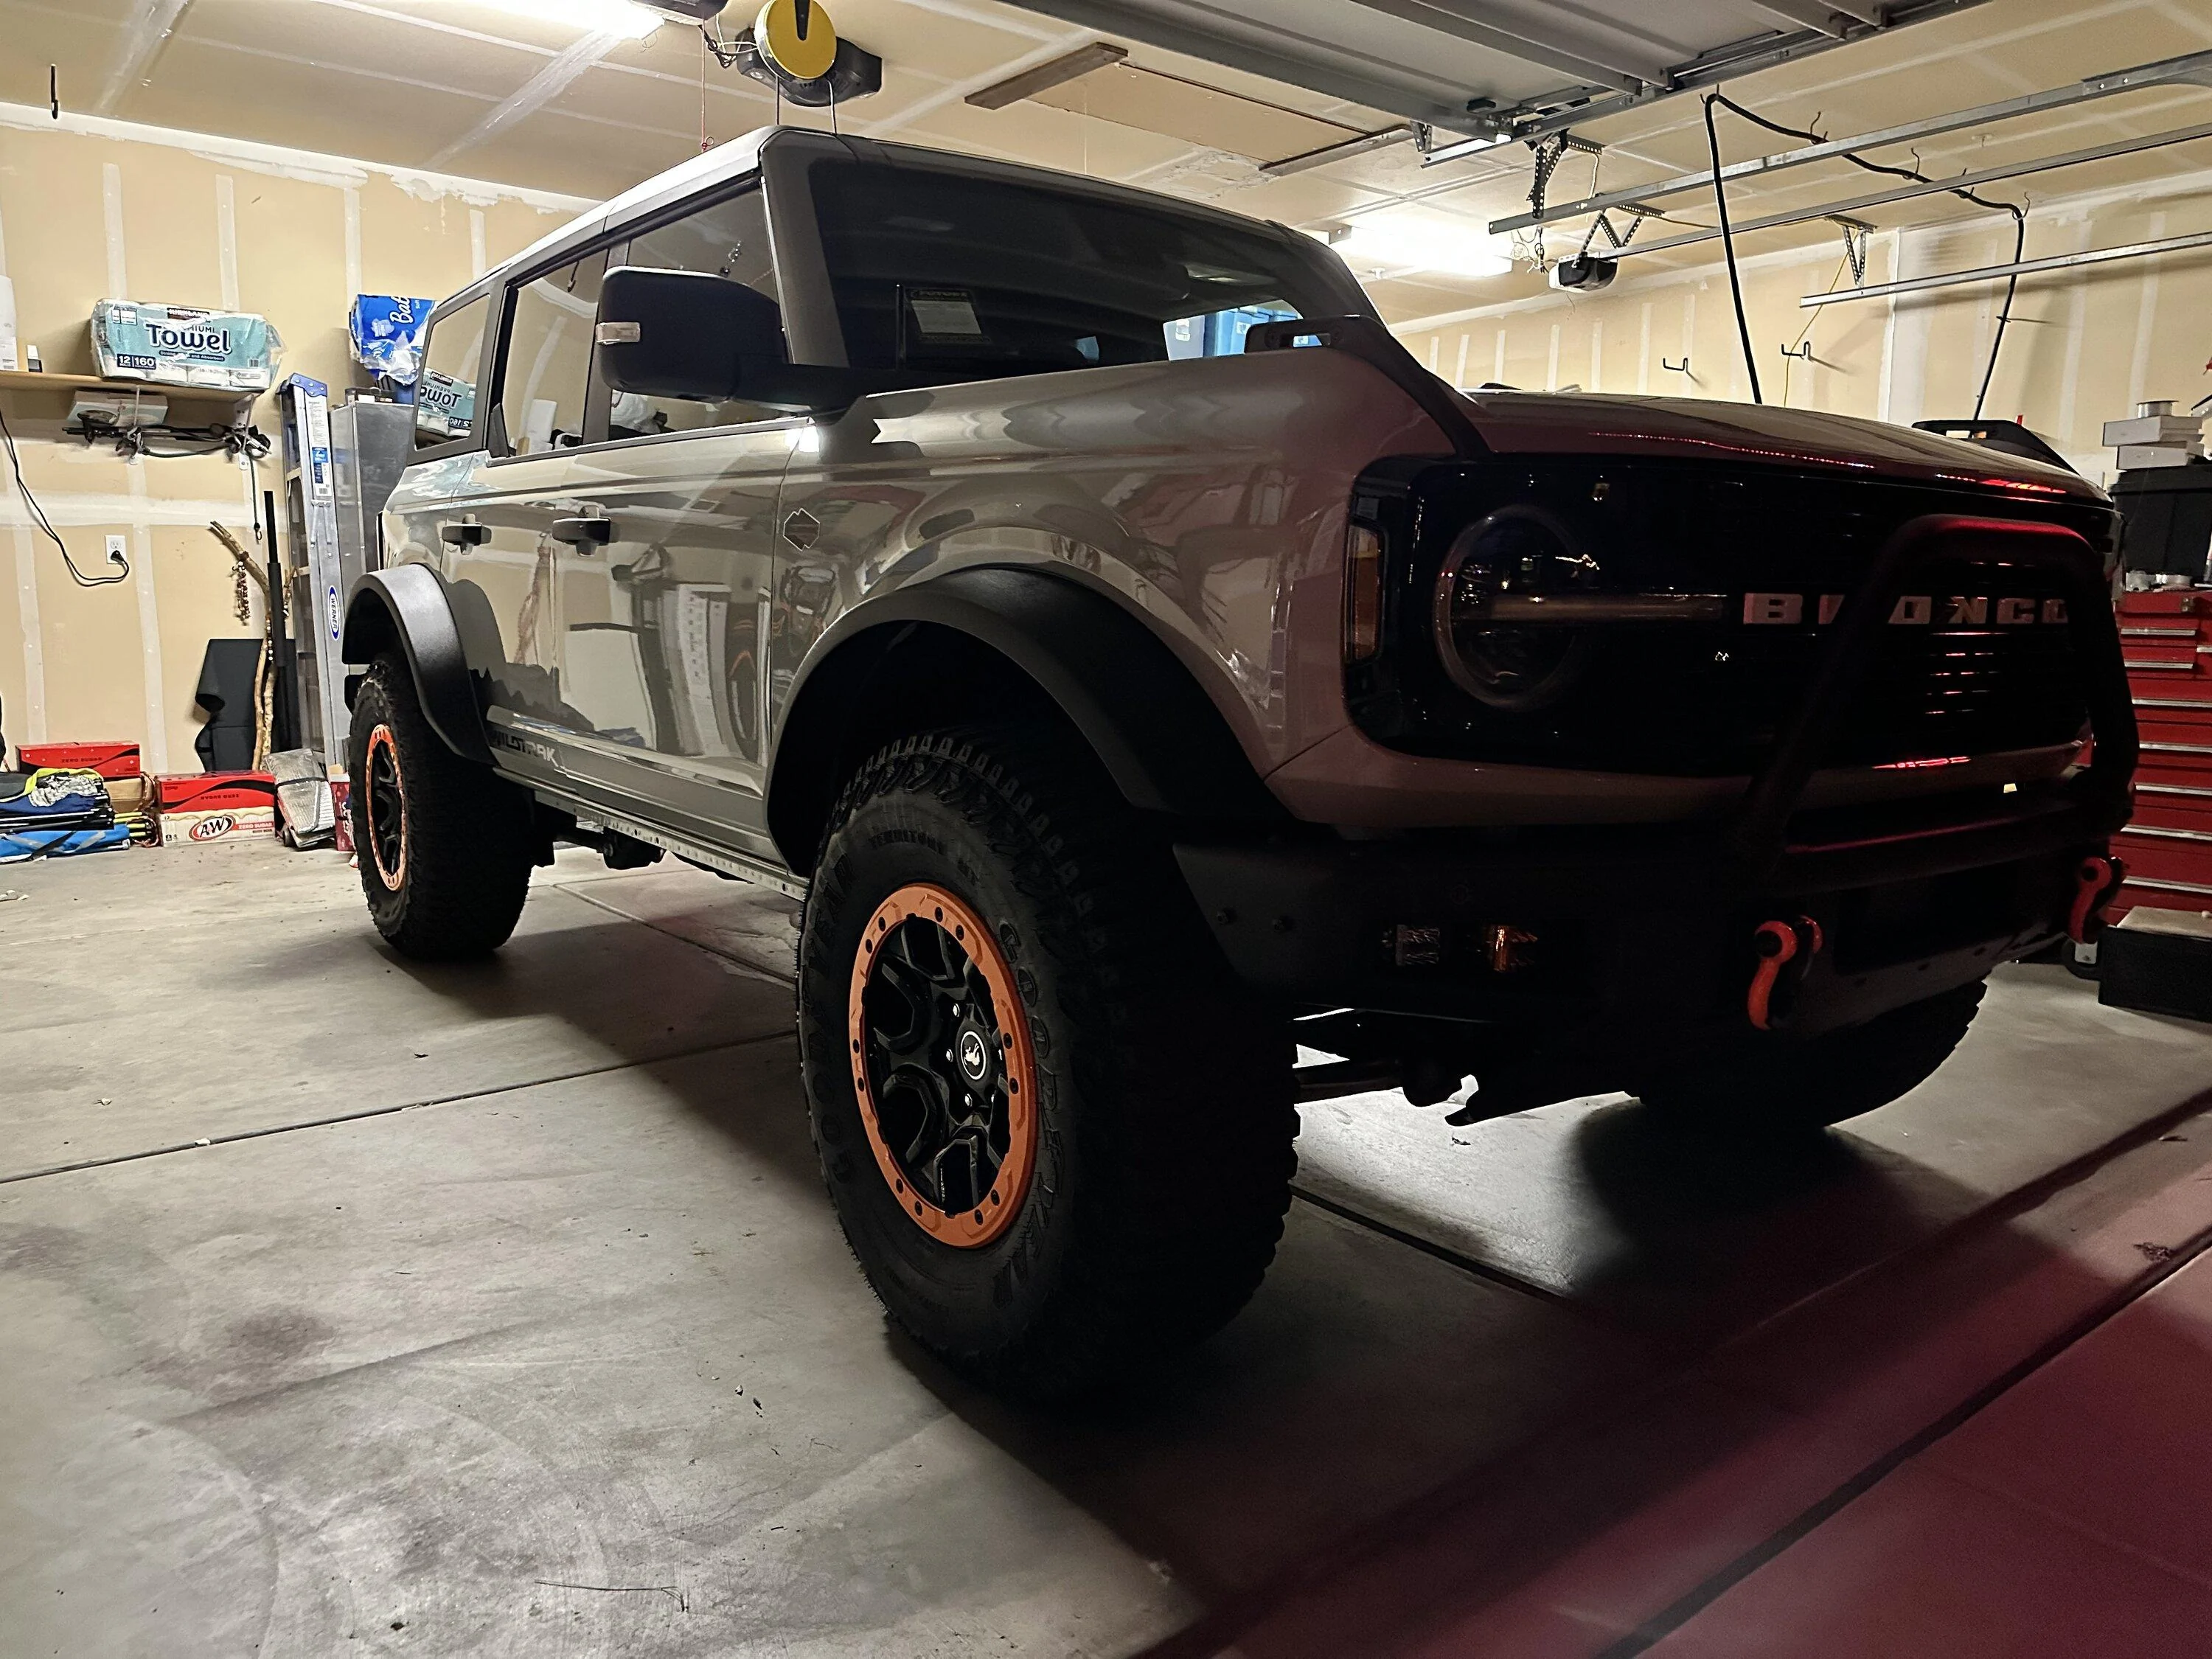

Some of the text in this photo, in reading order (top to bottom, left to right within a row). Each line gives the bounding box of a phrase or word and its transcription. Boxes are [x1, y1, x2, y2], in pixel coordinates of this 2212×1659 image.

[145, 323, 230, 352] Towel
[119, 355, 131, 364] 12
[134, 357, 155, 366] 160
